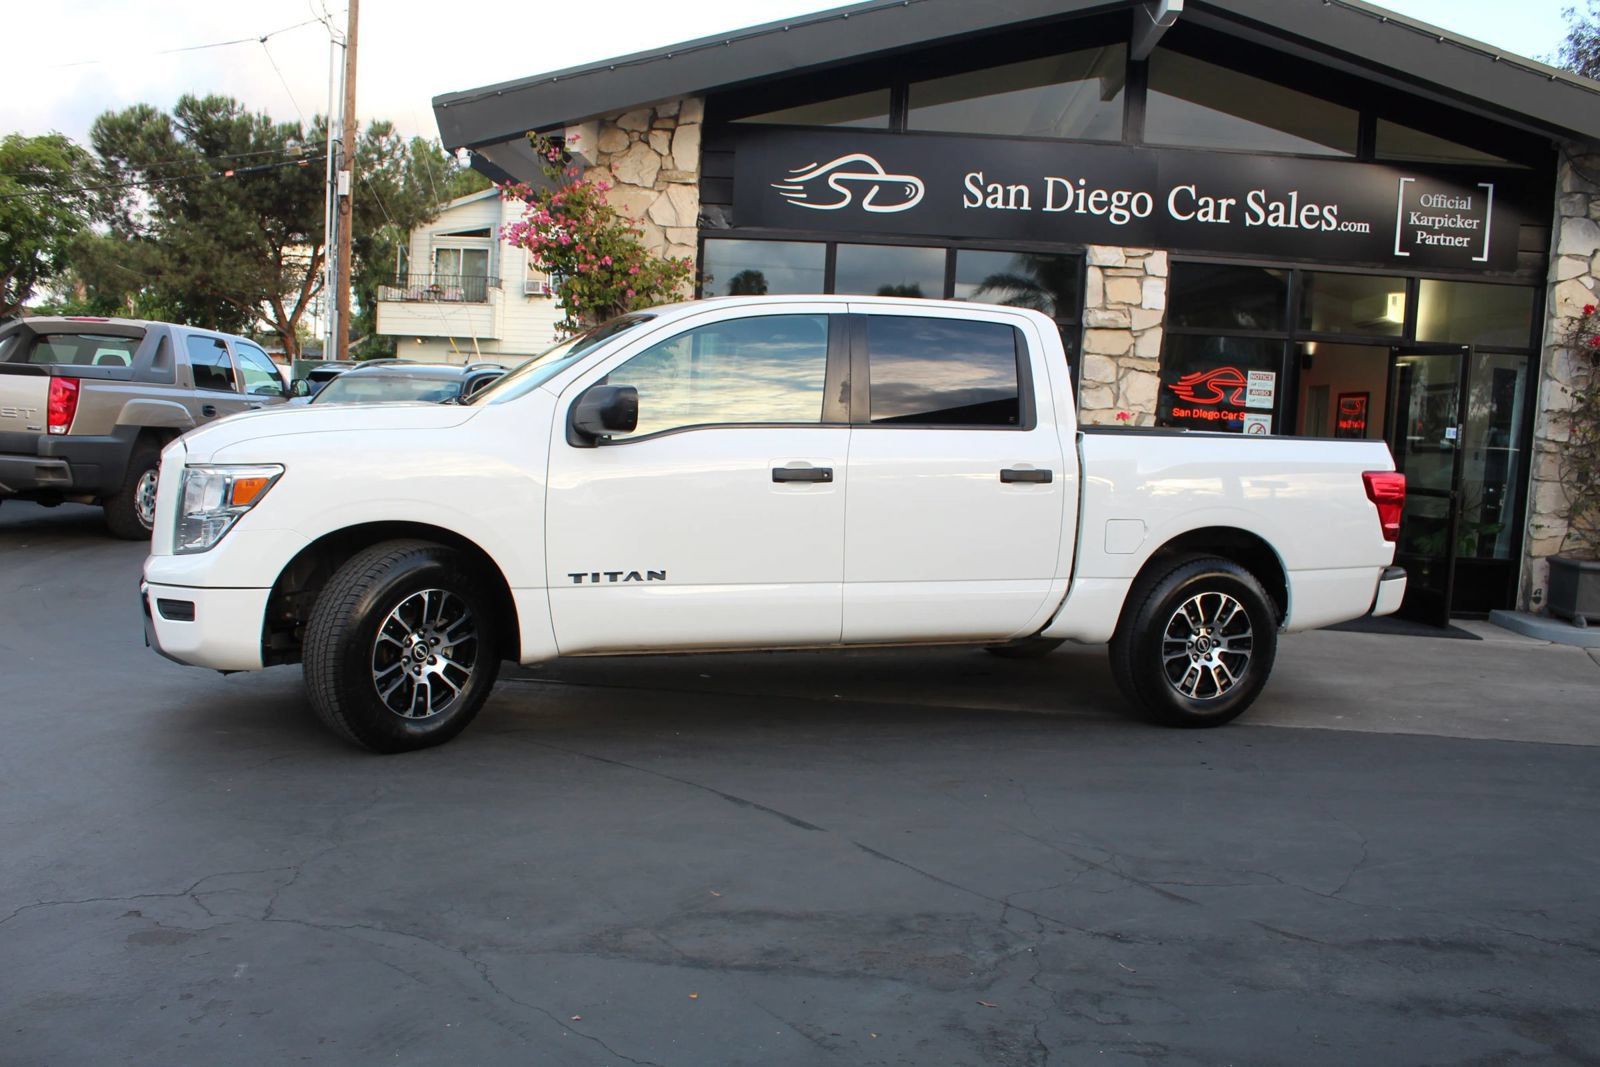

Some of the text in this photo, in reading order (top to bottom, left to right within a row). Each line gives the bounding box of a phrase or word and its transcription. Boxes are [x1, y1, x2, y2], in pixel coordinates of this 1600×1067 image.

[963, 171, 1032, 211] San
[1042, 176, 1154, 225] Diego
[1167, 184, 1237, 224] Car
[1420, 193, 1472, 211] Official
[1408, 211, 1480, 230] Karpicker
[1415, 230, 1471, 247] Partner
[1172, 407, 1191, 417] San
[1193, 408, 1220, 421] Diego
[1221, 410, 1239, 421] Car
[567, 570, 667, 584] TITAN
